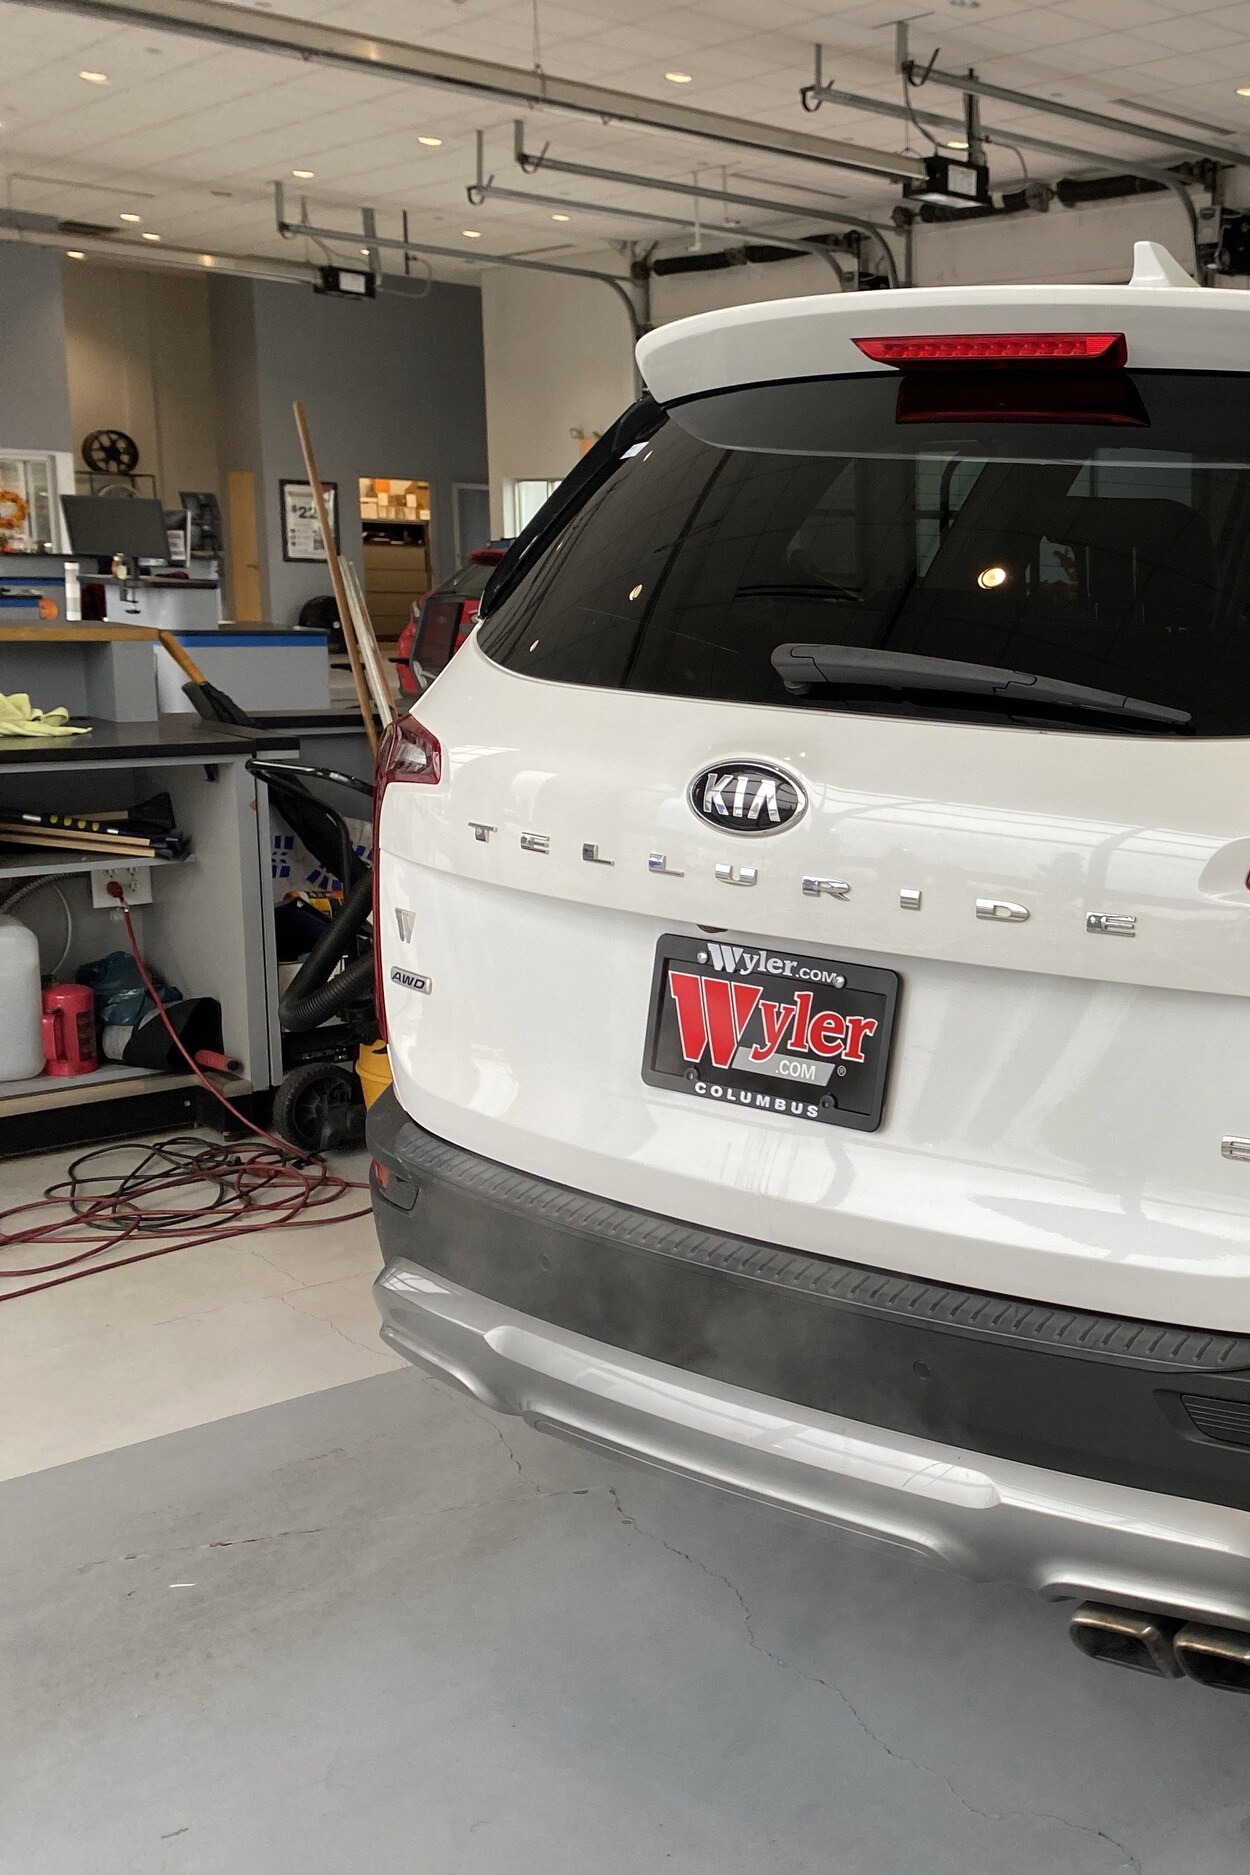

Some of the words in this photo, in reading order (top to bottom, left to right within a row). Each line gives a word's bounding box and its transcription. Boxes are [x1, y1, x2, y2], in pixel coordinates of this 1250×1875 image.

[703, 772, 781, 822] KIA
[467, 820, 1138, 938] TELLURIDE
[391, 971, 426, 990] AWD
[668, 969, 880, 1070] Wyler
[694, 1081, 820, 1119] COLUMBUS
